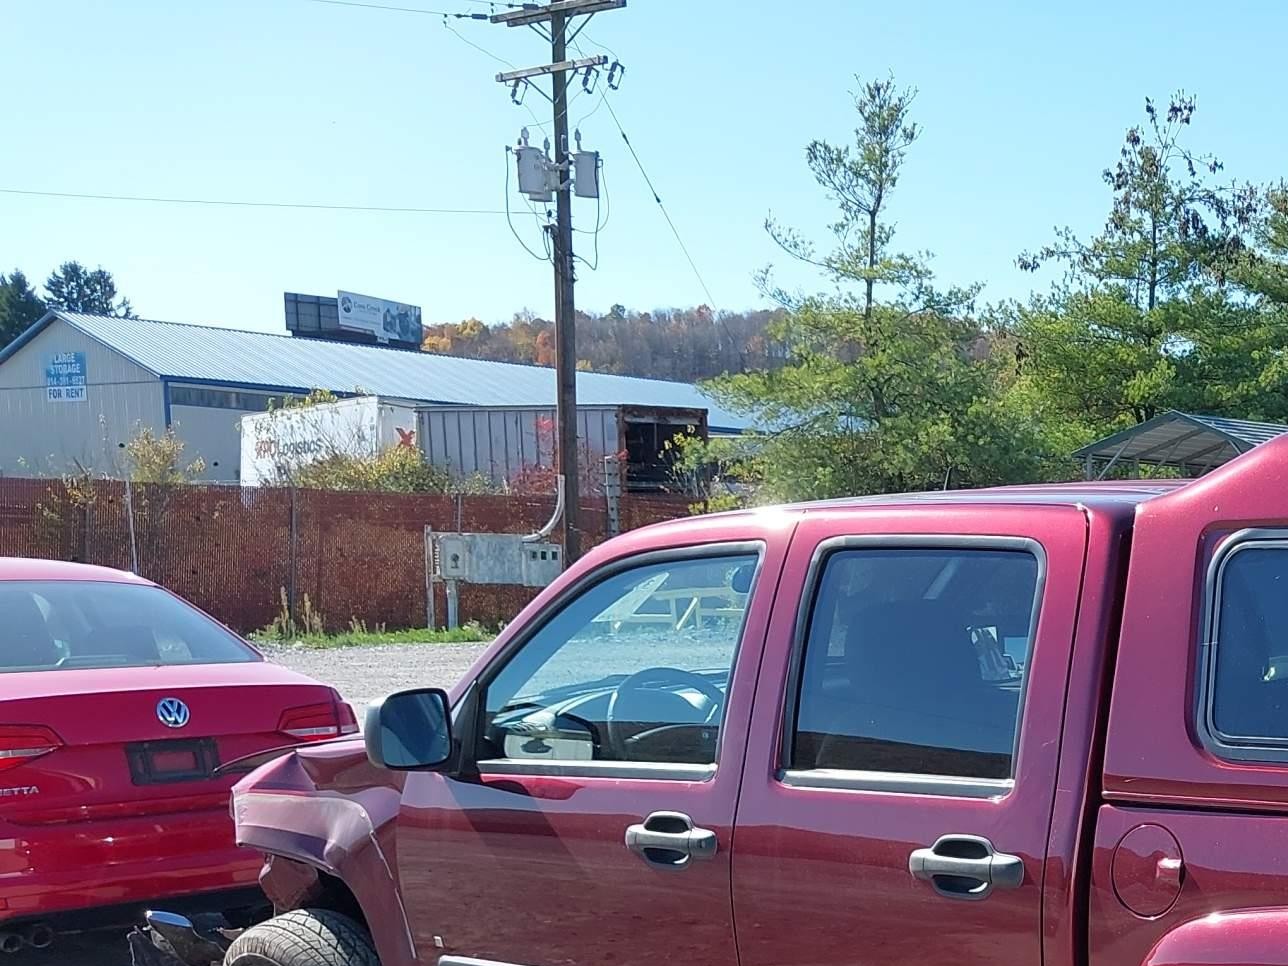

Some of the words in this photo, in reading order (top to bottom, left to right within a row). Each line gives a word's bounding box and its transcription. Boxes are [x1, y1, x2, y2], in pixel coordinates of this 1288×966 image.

[54, 353, 76, 363] LARGE
[50, 363, 81, 375] STORAGE
[48, 389, 62, 399] FOR
[65, 388, 84, 398] RENT
[278, 438, 322, 460] Logistics
